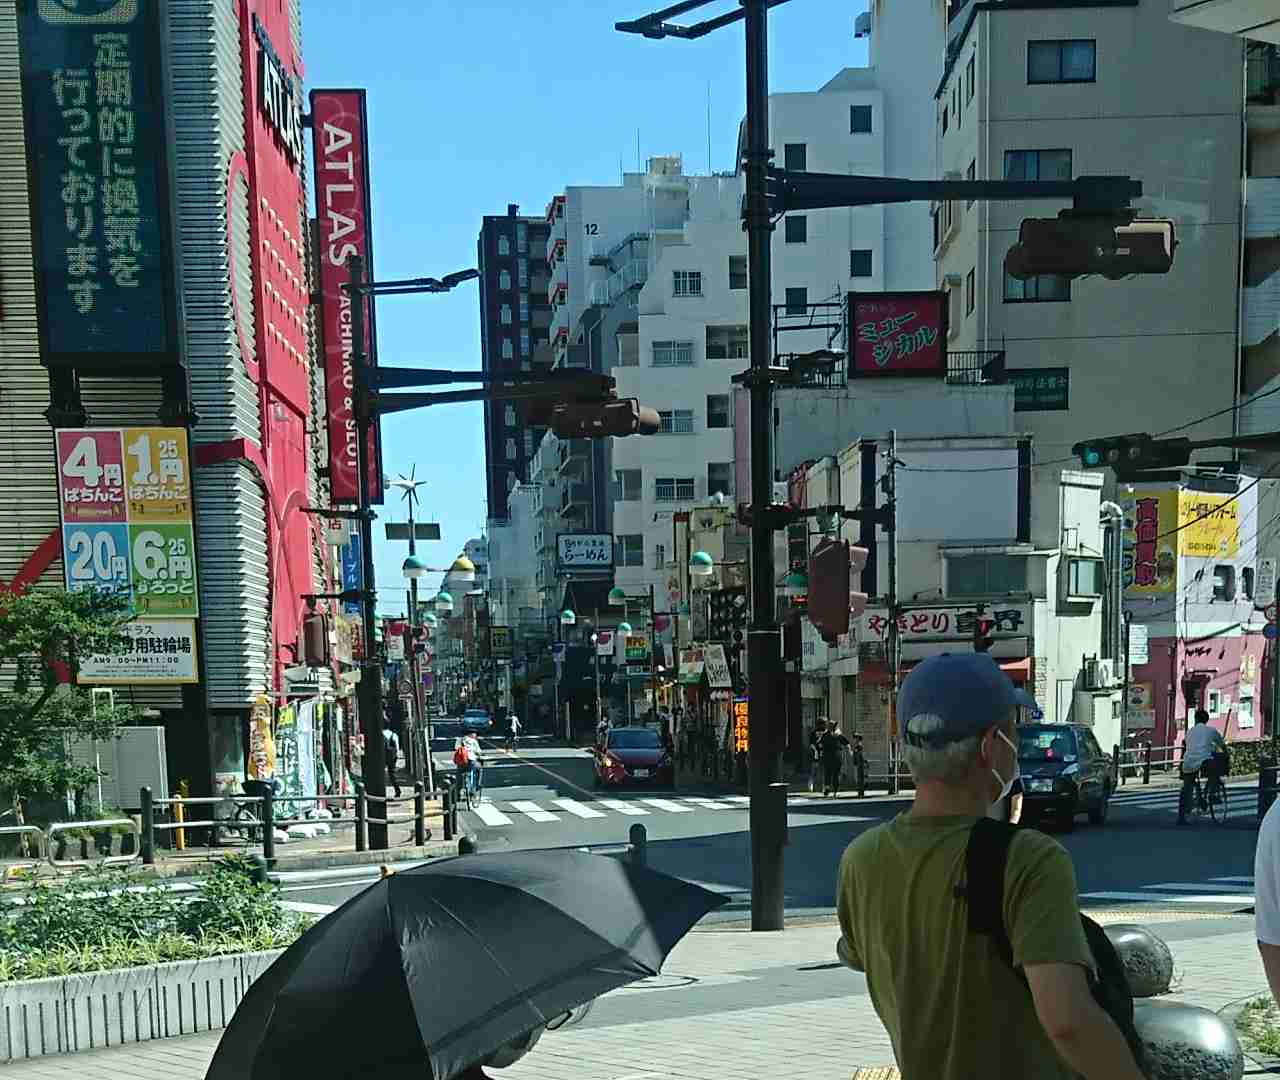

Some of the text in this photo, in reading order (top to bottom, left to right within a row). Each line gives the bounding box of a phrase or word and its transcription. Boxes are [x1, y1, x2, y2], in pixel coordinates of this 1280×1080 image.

[52, 67, 101, 314] 行っております
[322, 122, 358, 267] ATLAS
[340, 283, 355, 390] ACHINKO
